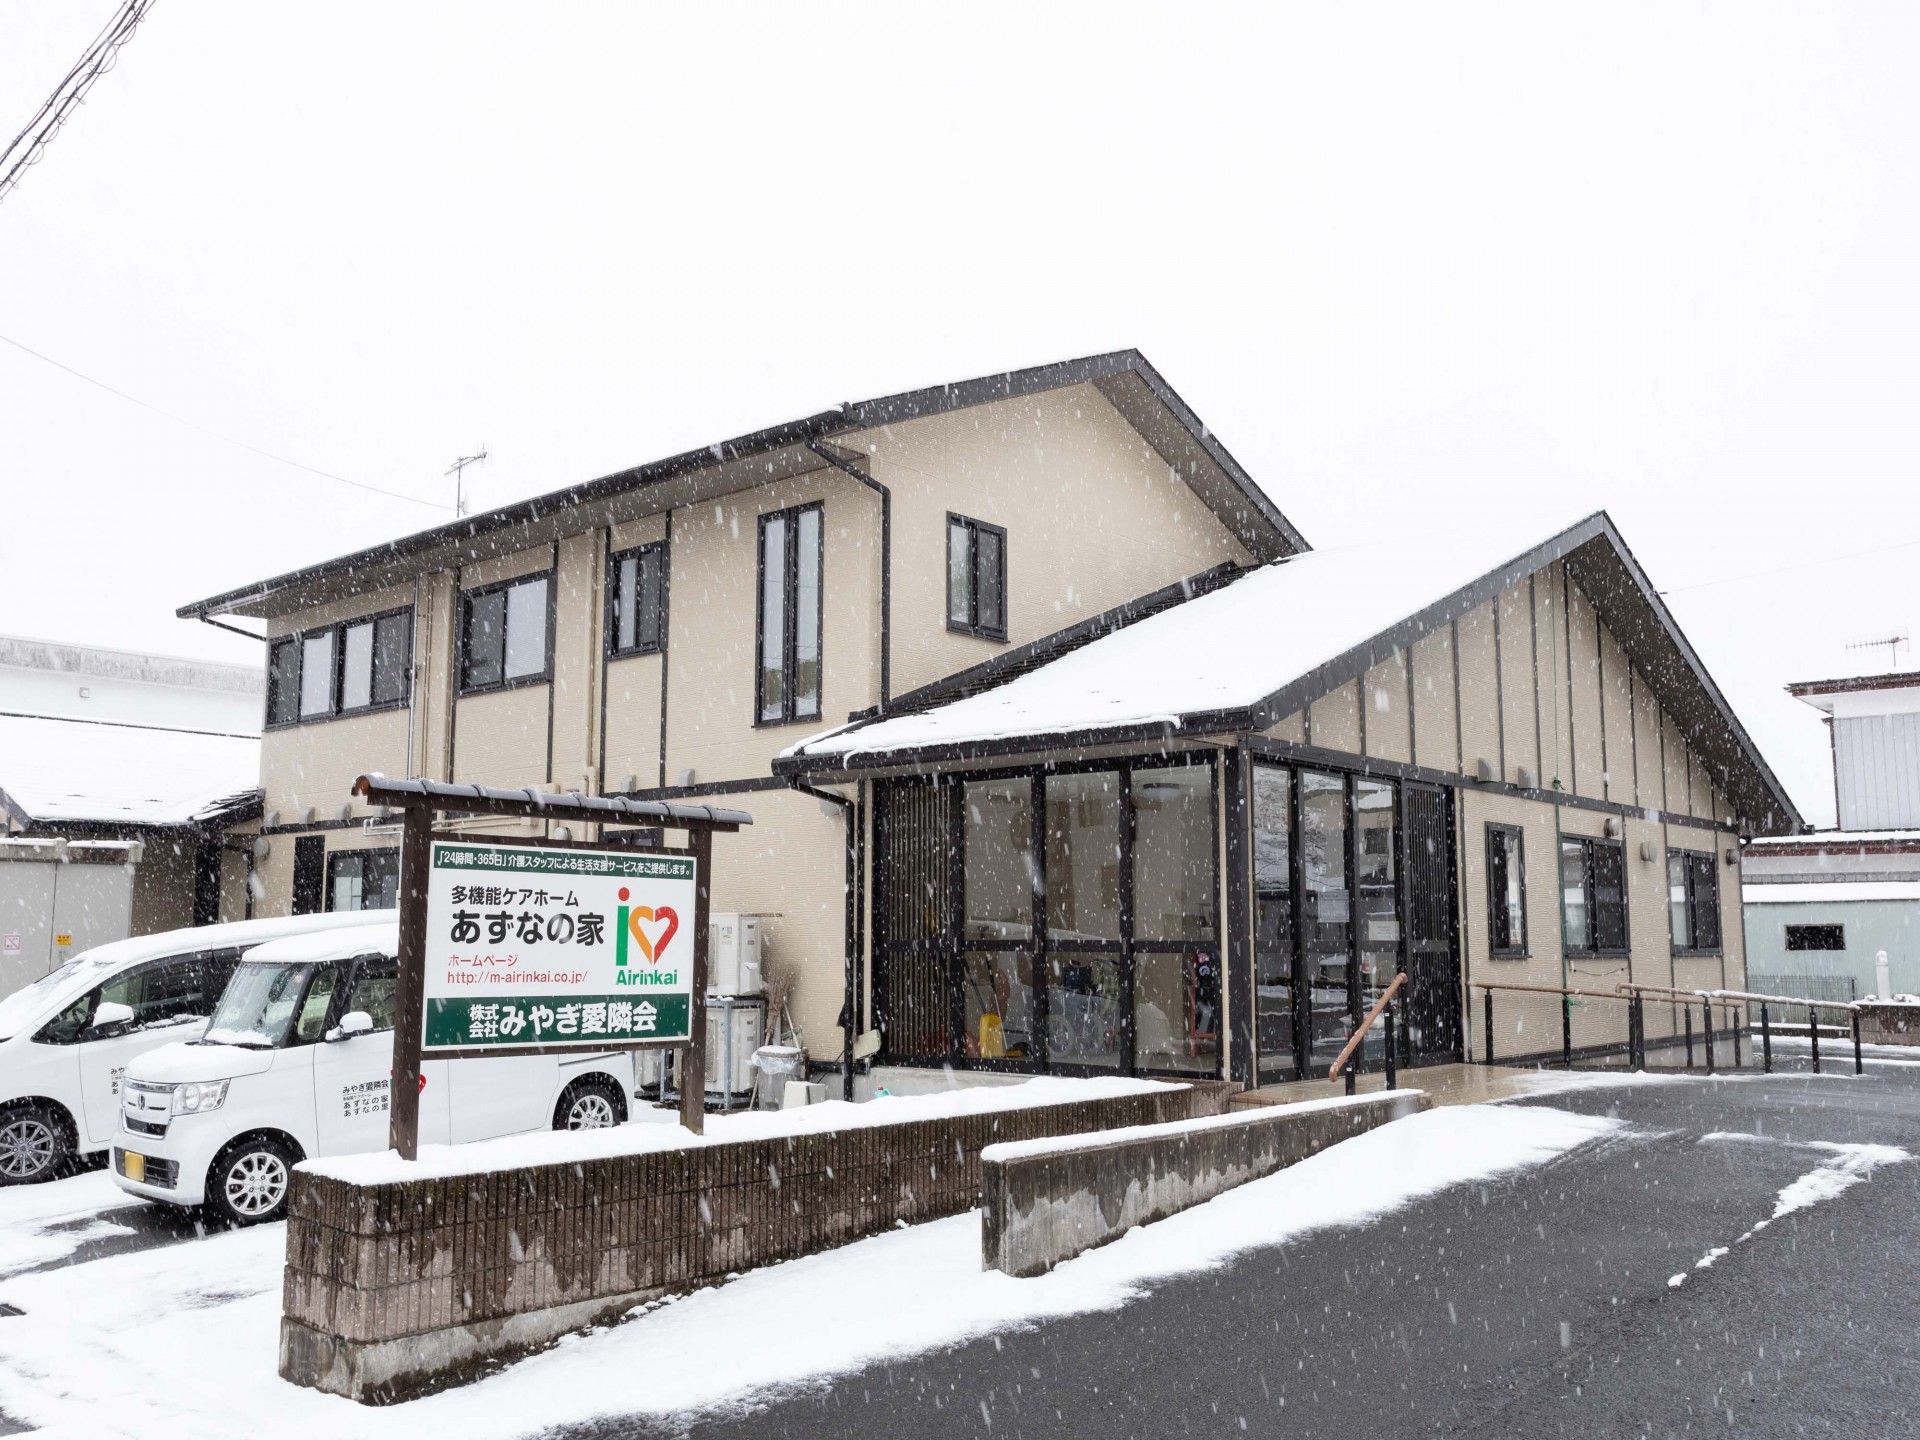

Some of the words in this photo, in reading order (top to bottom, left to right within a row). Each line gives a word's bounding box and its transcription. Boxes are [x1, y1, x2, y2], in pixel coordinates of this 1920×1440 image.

[451, 885, 579, 907] 多機能ケアホーム
[450, 909, 605, 946] あずなの家
[448, 954, 518, 967] ホームページ
[447, 970, 588, 985] http://m-airinkai.co.jp/
[616, 969, 678, 986] Airinkai
[500, 1001, 657, 1036] みやぎ愛隣会
